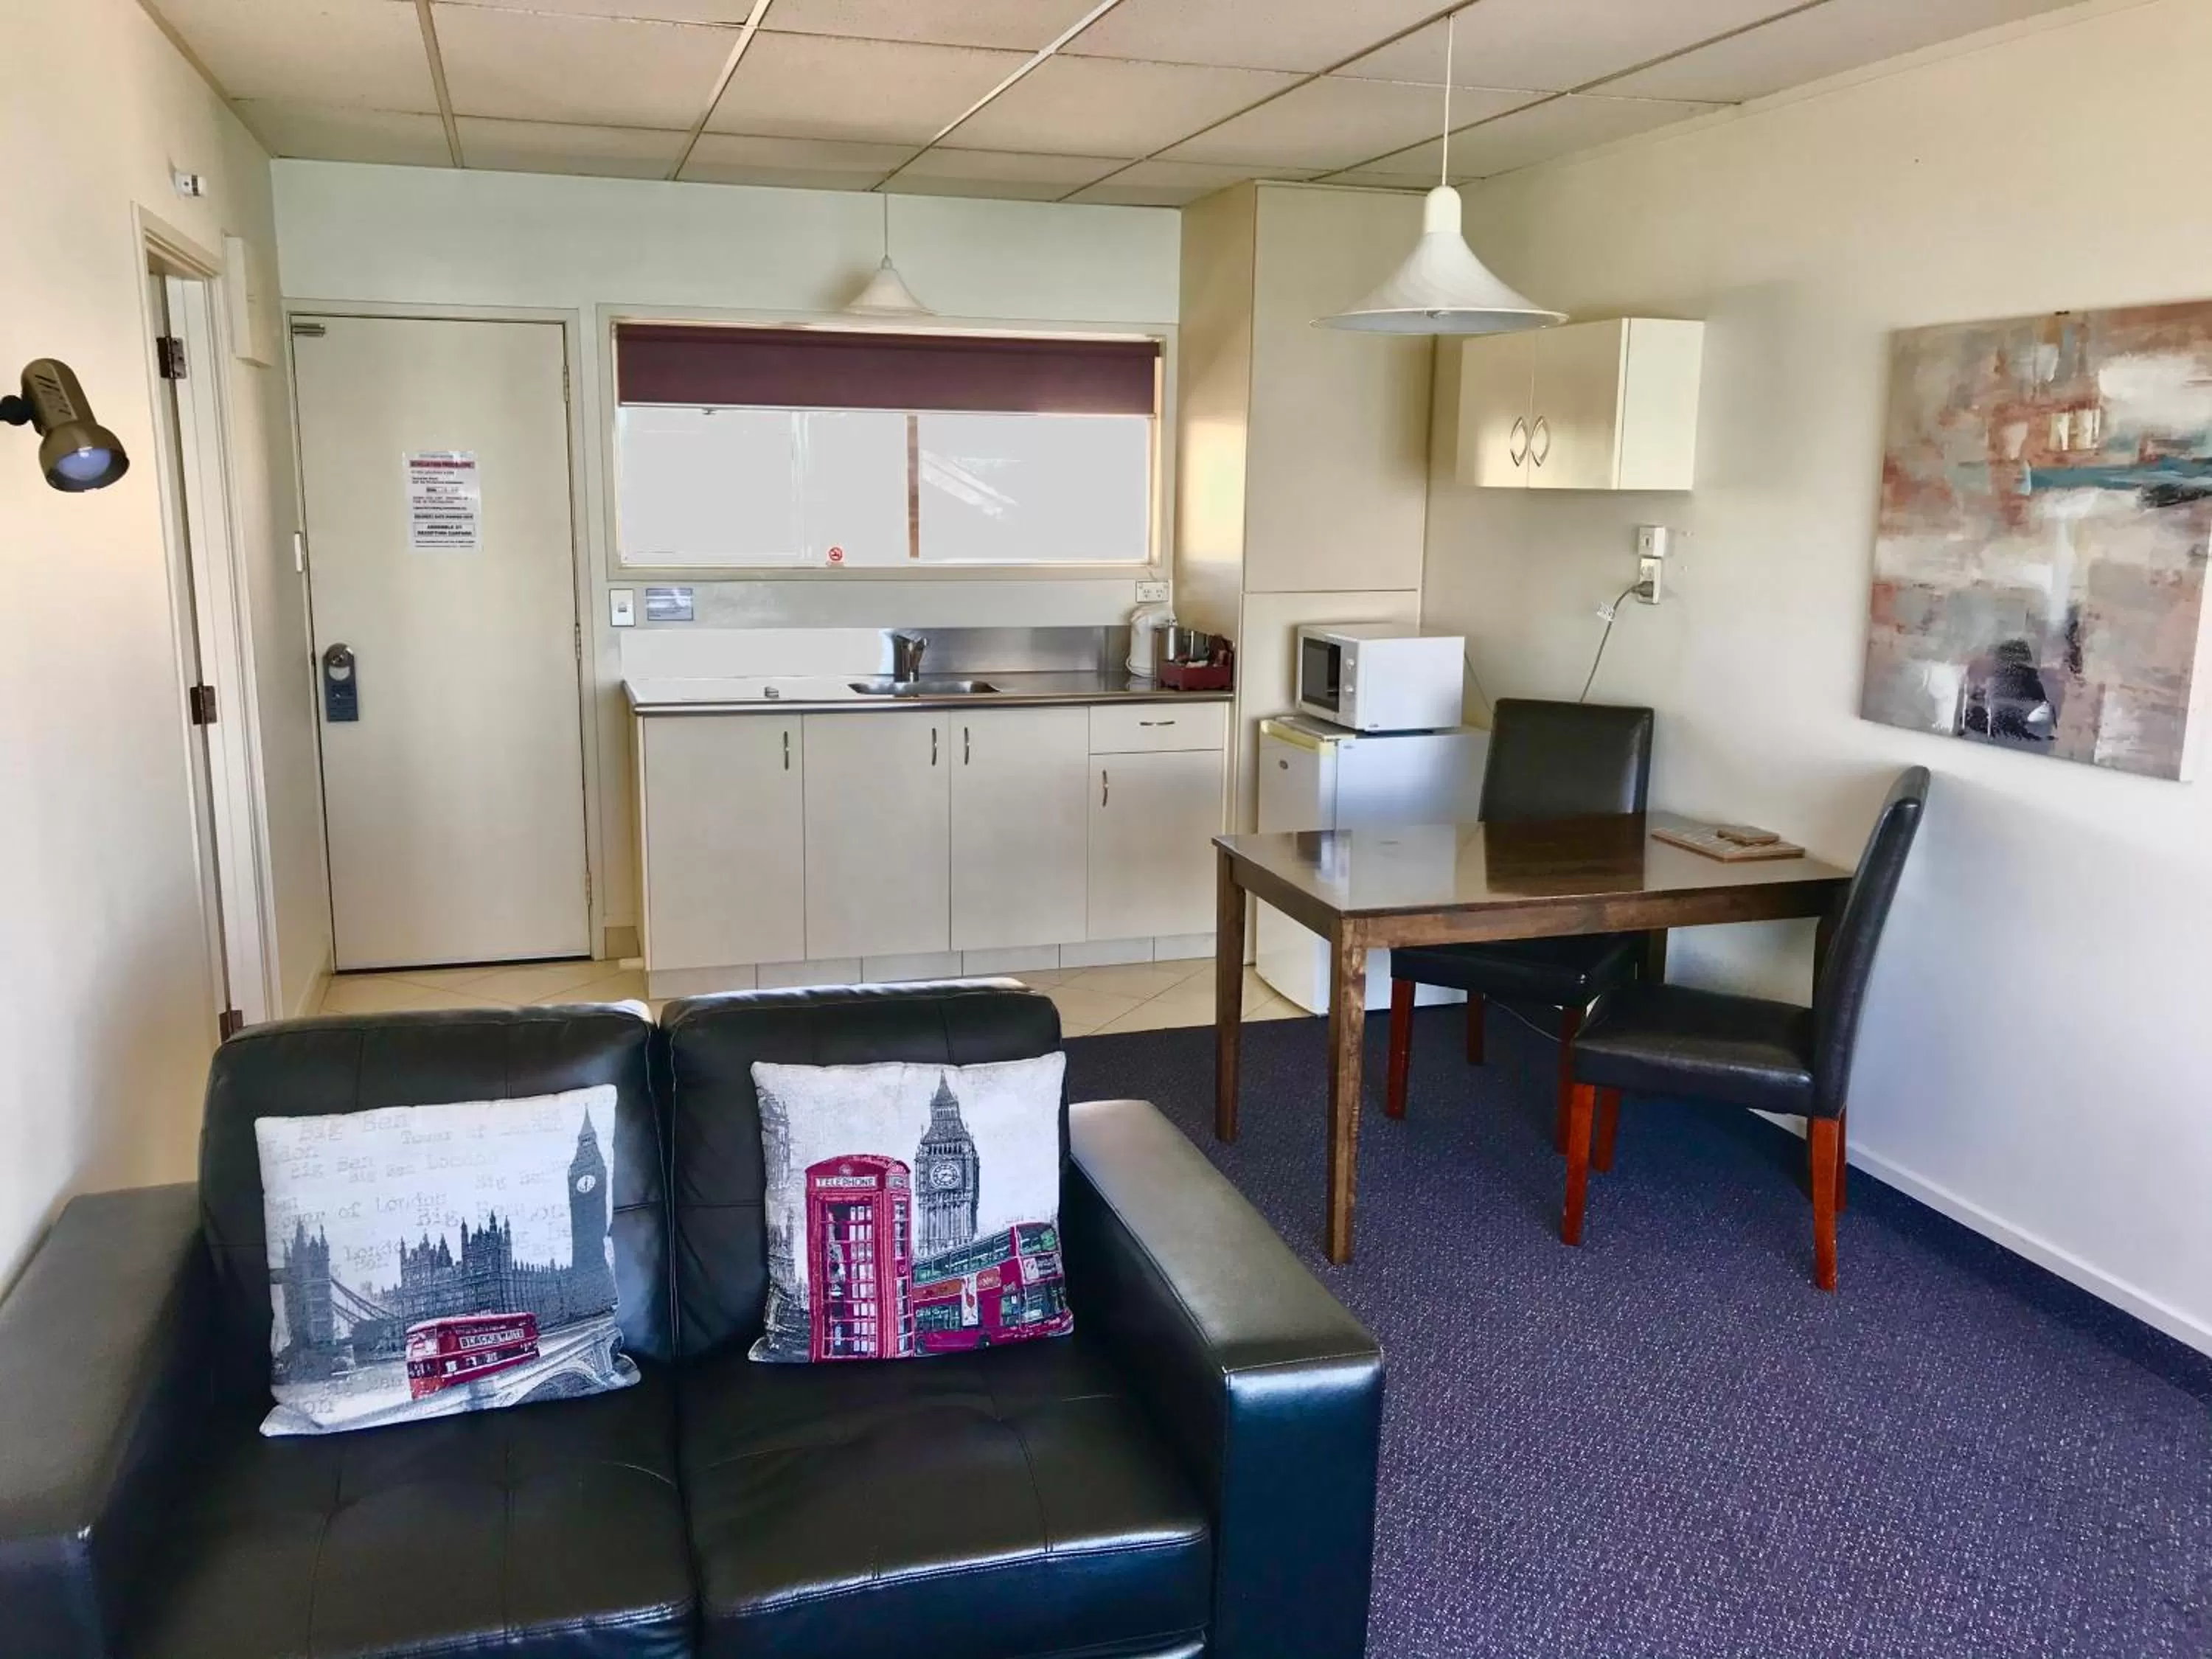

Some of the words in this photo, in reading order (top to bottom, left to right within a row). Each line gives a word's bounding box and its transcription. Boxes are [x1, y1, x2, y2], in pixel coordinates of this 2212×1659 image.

[818, 1178, 874, 1187] TELEPHONE
[460, 1334, 493, 1347] BLACK
[499, 1329, 524, 1340] WHITE
